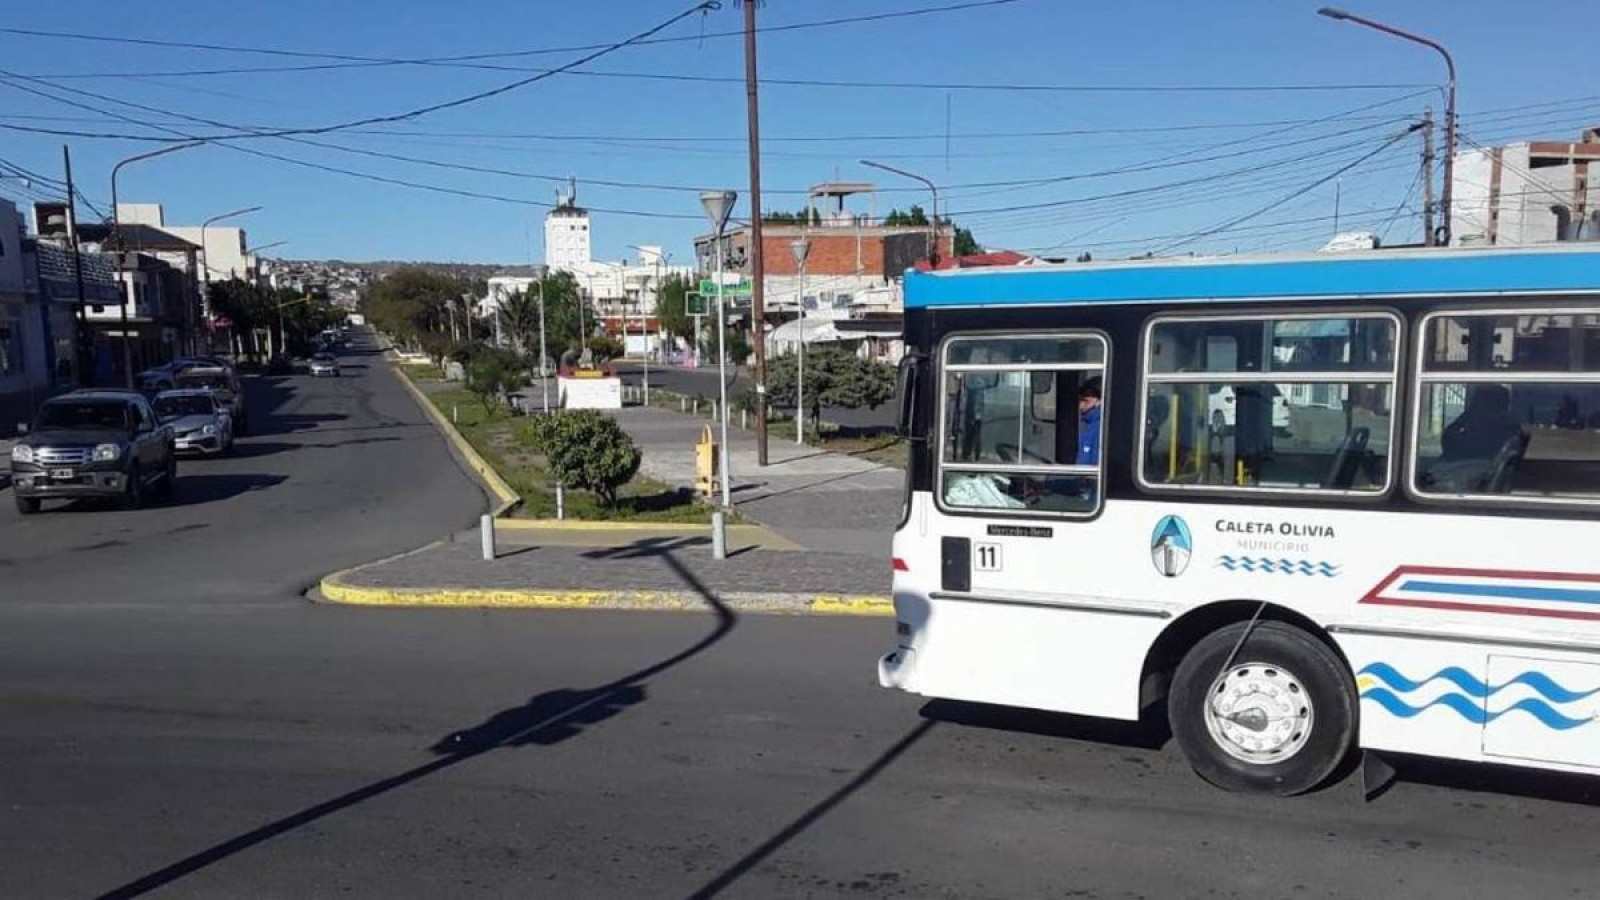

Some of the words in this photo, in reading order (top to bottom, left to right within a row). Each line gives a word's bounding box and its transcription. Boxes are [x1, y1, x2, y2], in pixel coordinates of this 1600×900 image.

[1215, 519, 1274, 534] CALETA
[1279, 522, 1335, 538] OLIVIA
[1237, 539, 1310, 553] MUNICIPIO
[978, 546, 996, 568] 11
